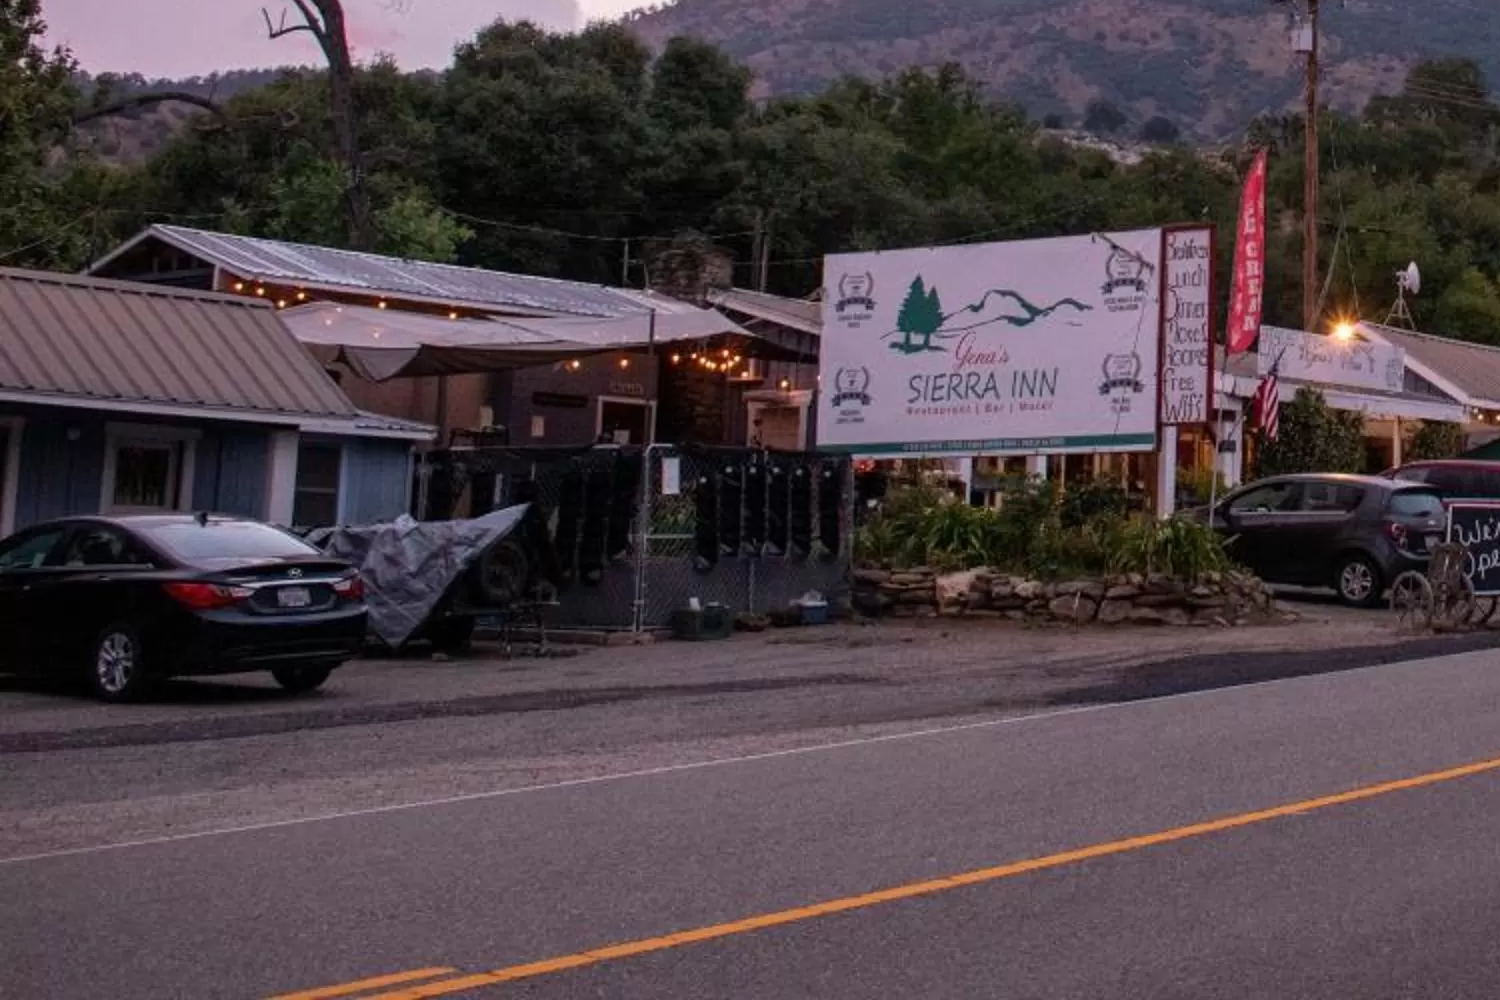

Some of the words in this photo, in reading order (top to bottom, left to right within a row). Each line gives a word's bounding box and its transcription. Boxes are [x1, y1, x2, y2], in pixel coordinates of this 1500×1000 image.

[907, 370, 1000, 404] SIERRA
[1011, 367, 1059, 399] INN
[1163, 366, 1195, 393] Free
